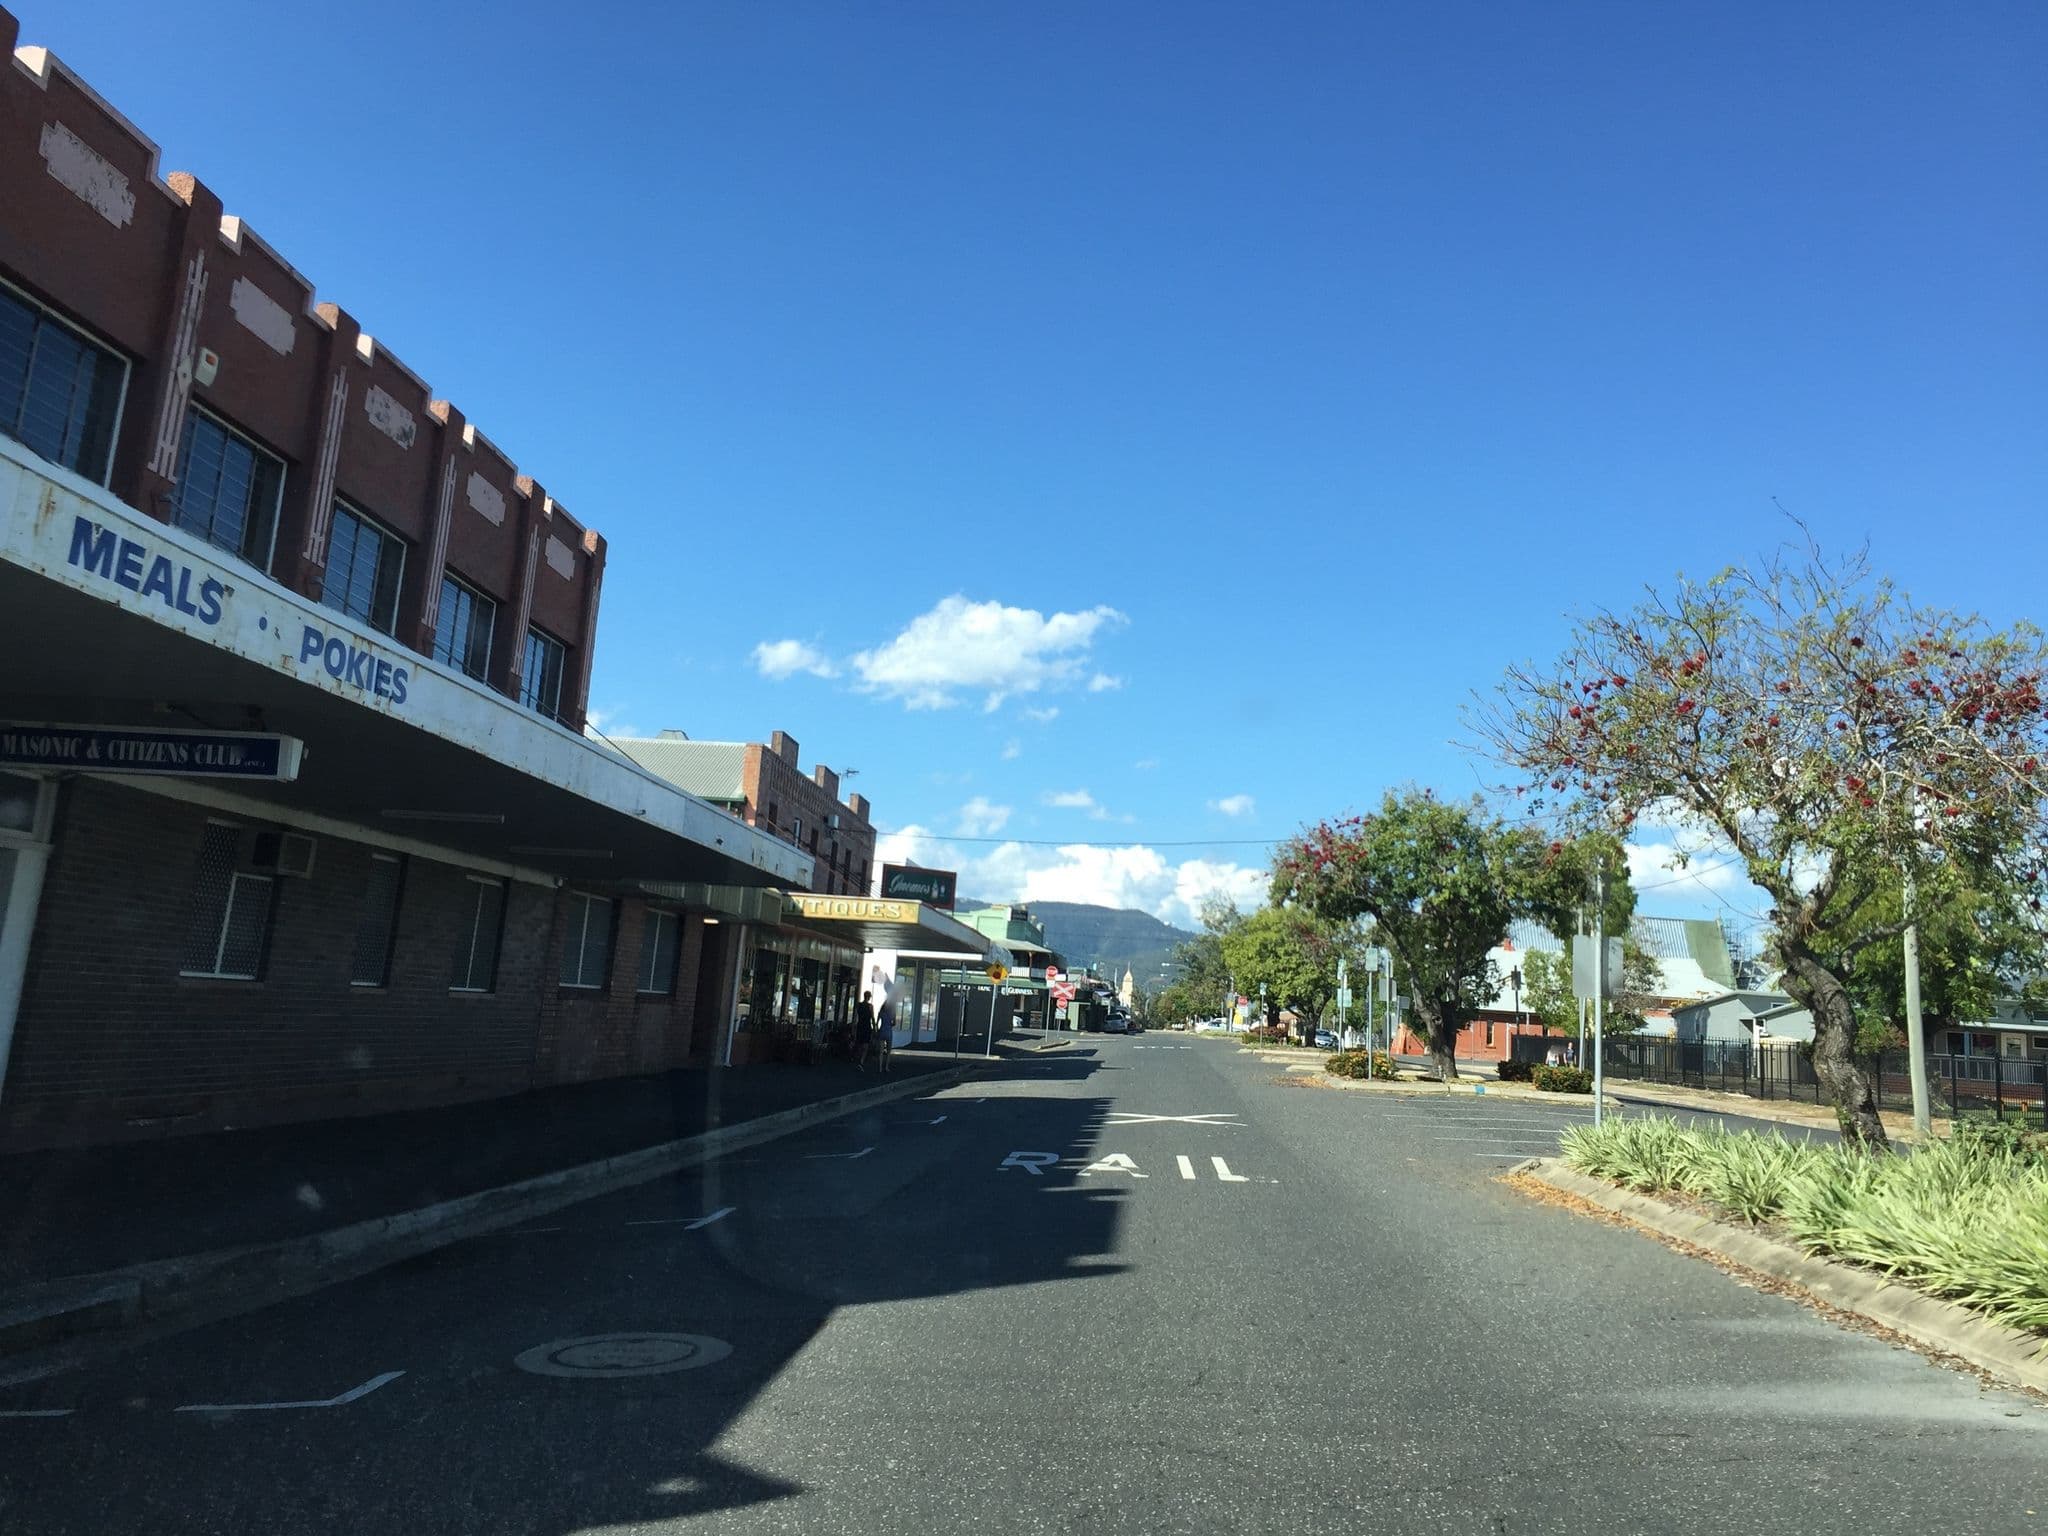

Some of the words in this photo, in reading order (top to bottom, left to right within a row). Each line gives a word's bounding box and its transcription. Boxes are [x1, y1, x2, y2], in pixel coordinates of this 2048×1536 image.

[67, 515, 226, 625] MEALS
[299, 625, 409, 705] POKIES
[2, 734, 83, 758] MASONIC
[87, 738, 103, 760] &
[107, 739, 189, 764] CITIZENS
[997, 1151, 1250, 1182] RAIL
